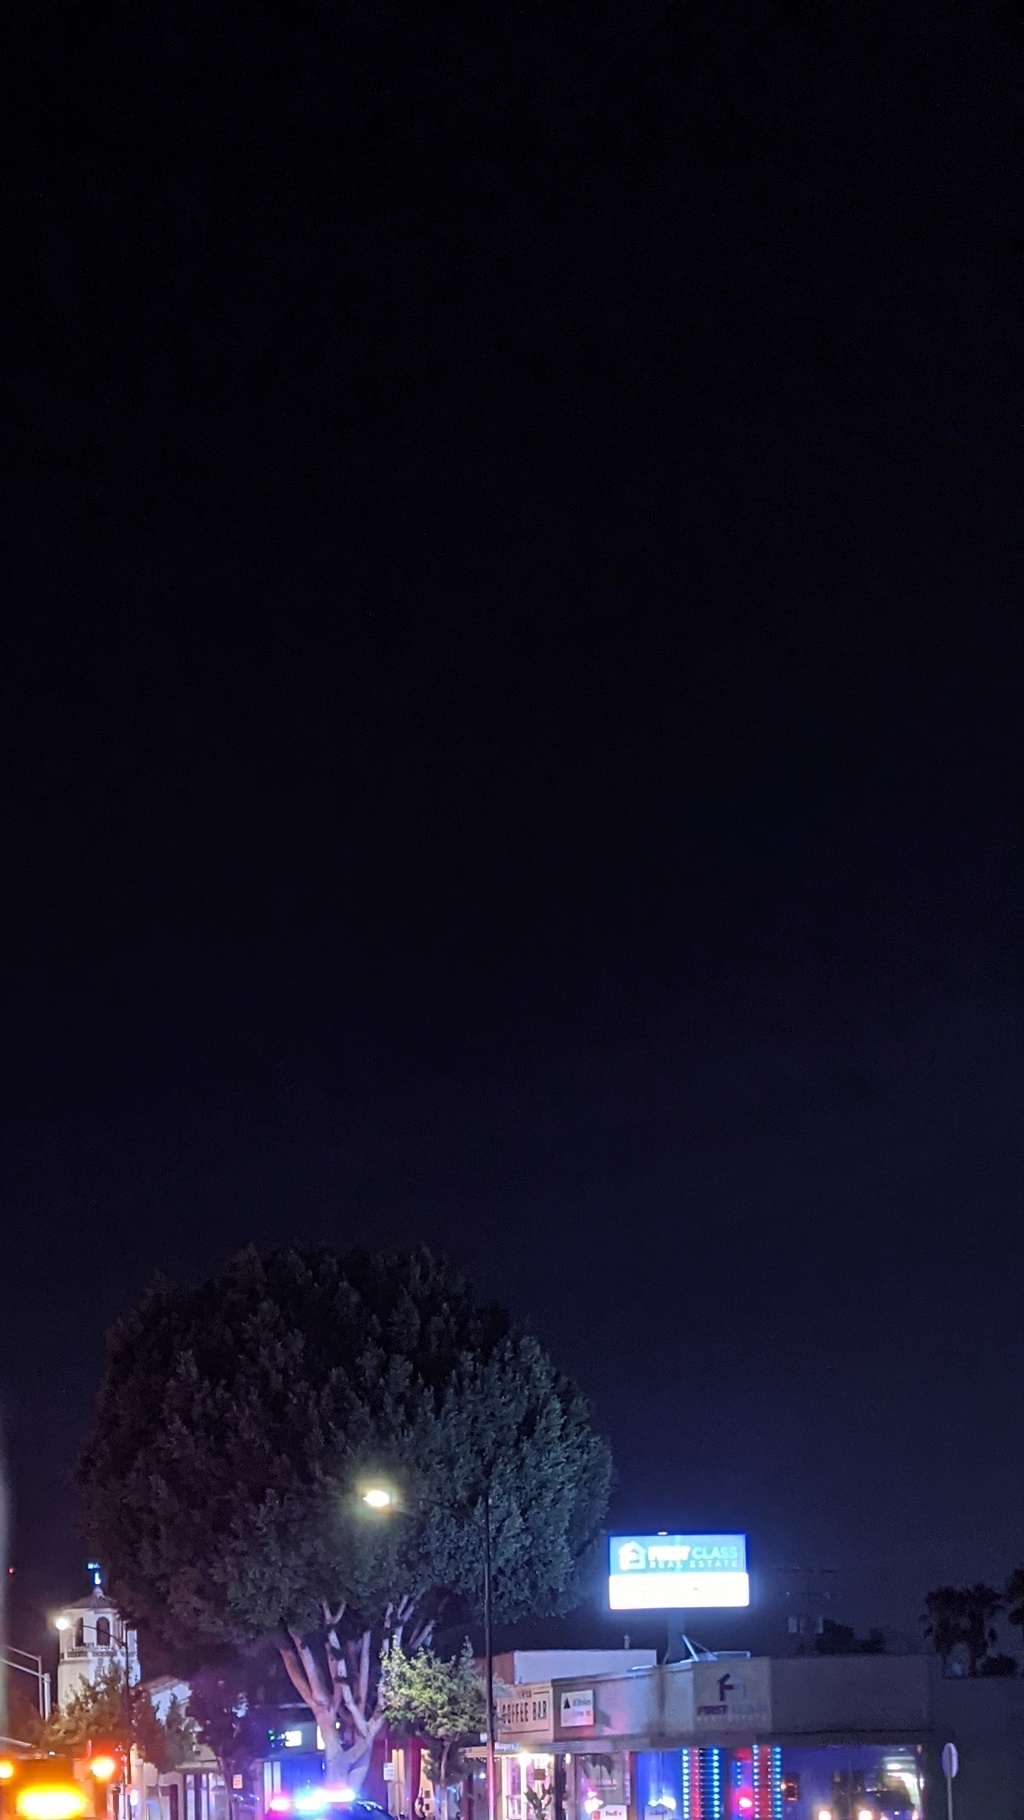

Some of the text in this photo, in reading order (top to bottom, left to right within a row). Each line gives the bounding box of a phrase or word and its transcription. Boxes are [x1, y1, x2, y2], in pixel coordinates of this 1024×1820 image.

[692, 1546, 738, 1560] CLASS
[649, 1560, 738, 1568] REAL ESTATE
[502, 1700, 547, 1724] COFFEE BAR
